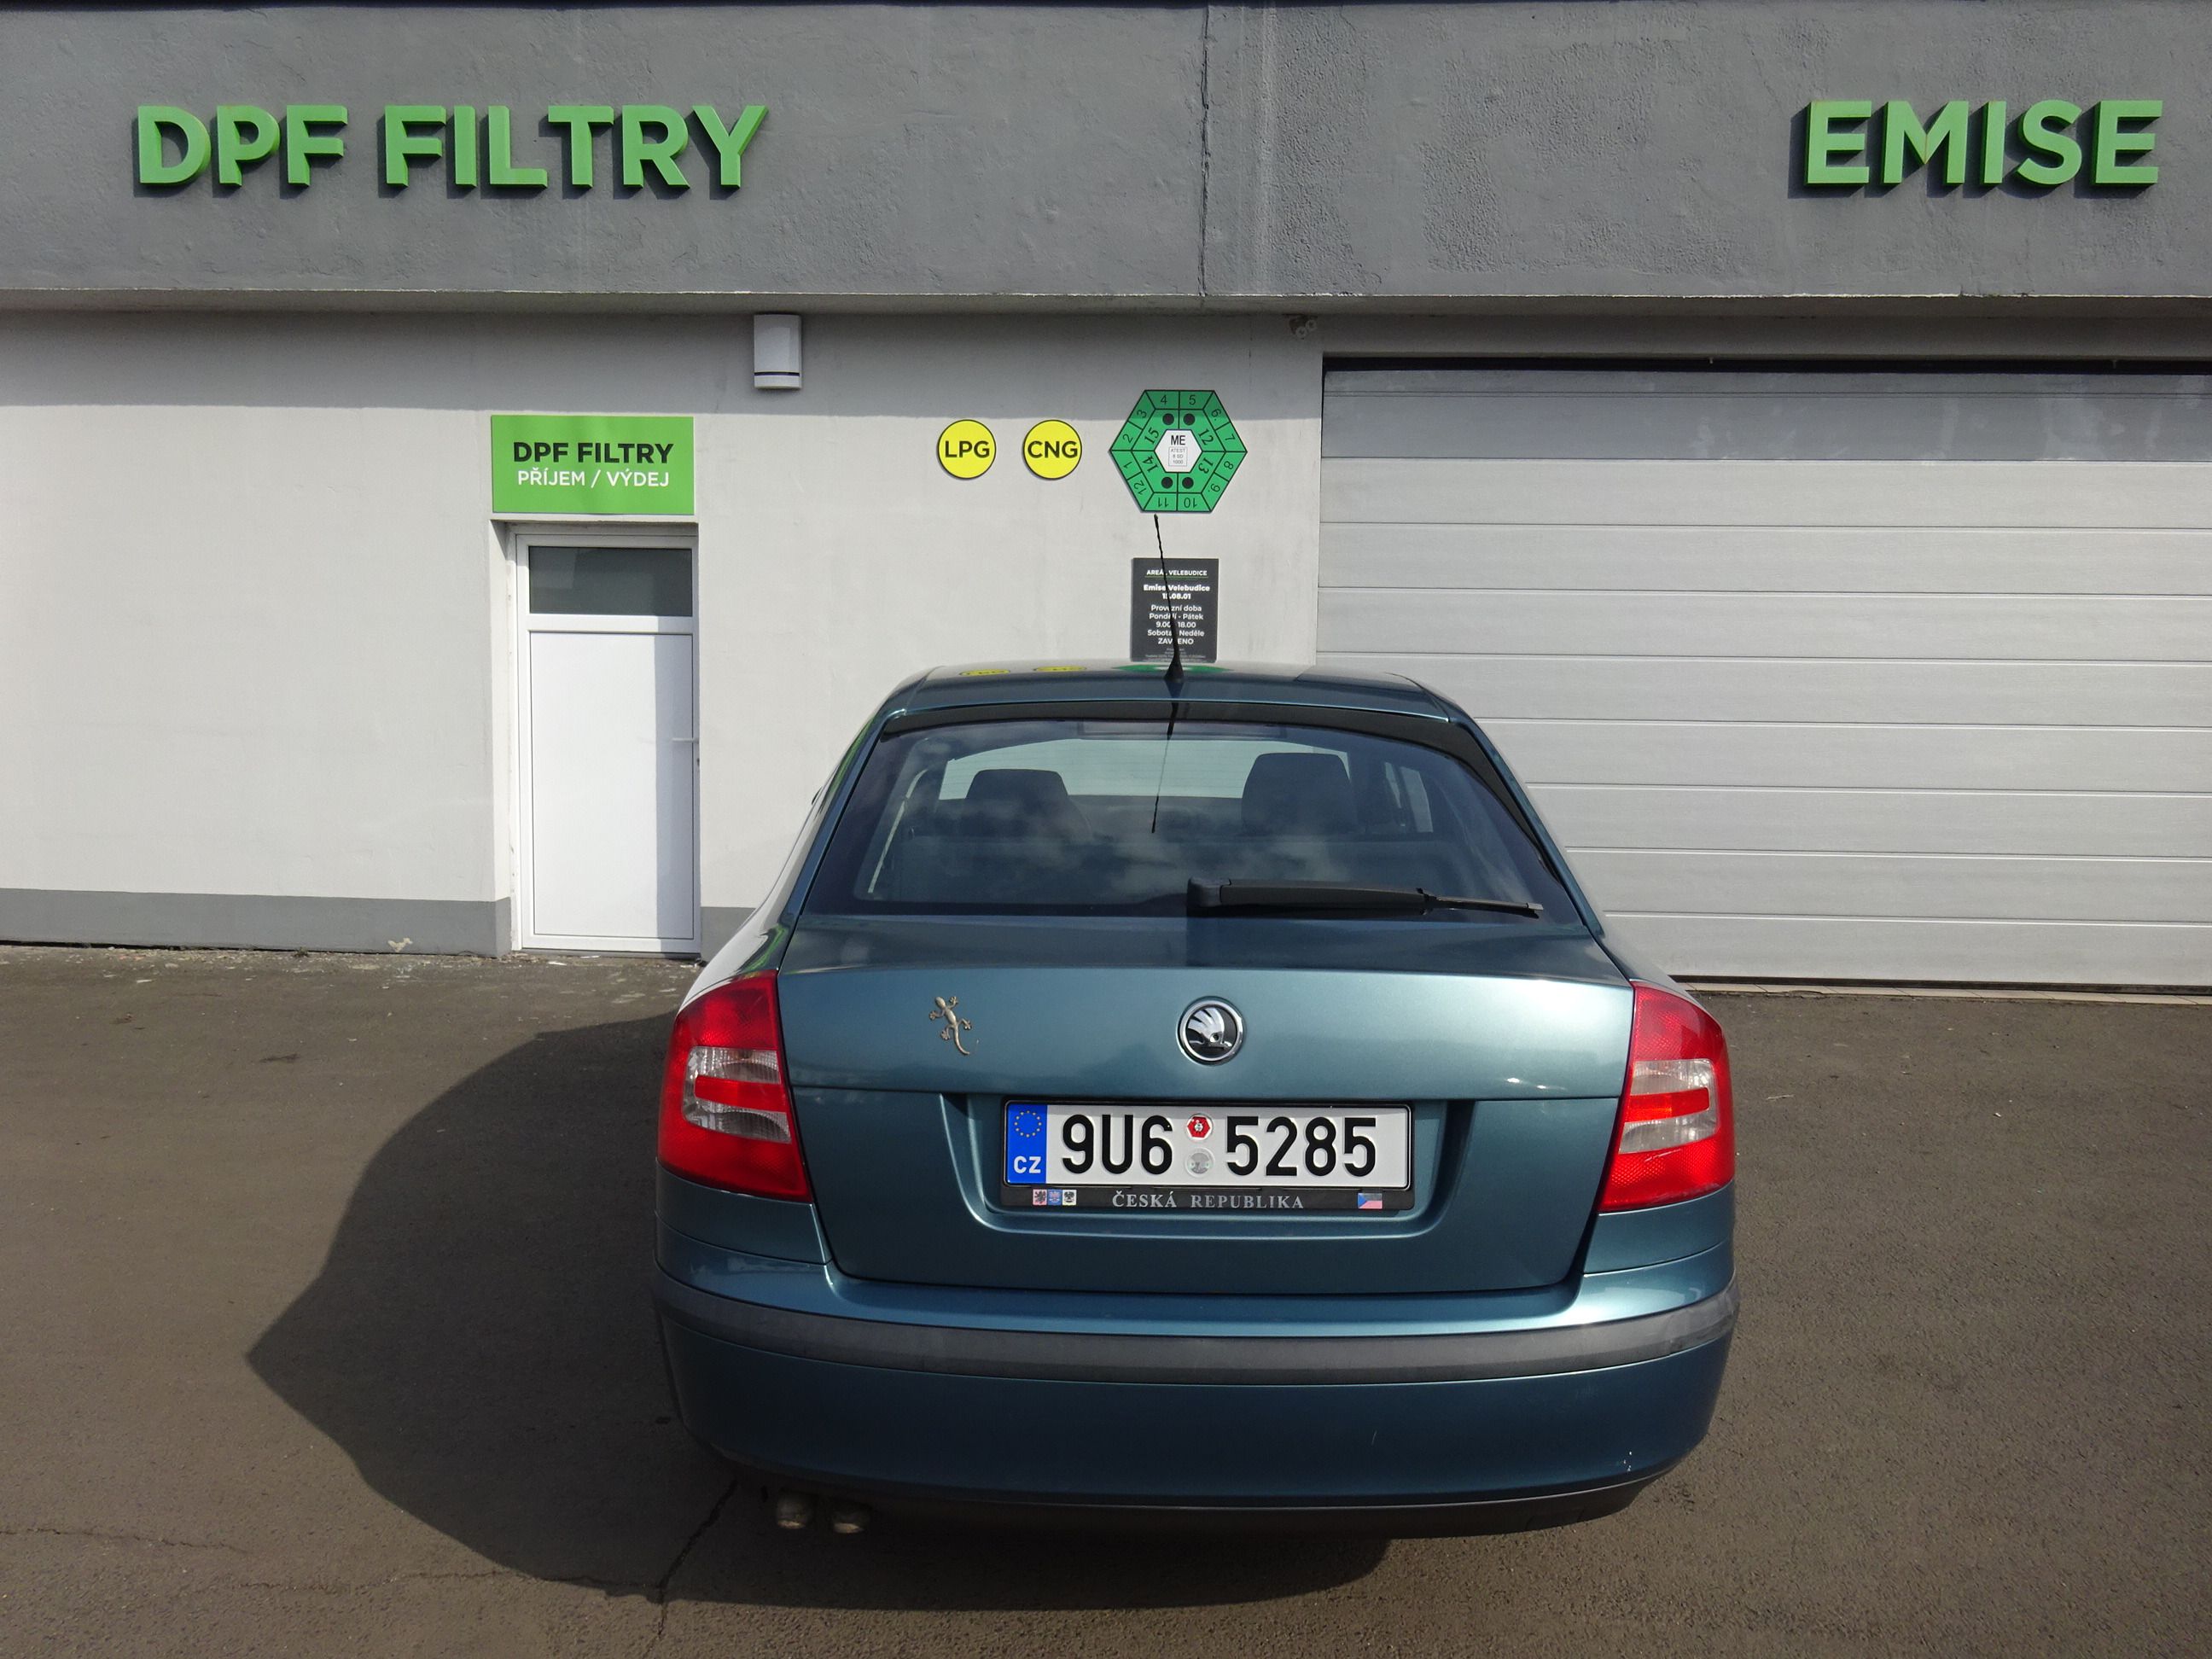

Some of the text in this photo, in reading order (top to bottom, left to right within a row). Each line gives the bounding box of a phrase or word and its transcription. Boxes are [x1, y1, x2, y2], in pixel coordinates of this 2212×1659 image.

[137, 105, 768, 189] DPF FILTRY
[1805, 100, 2163, 186] EMISE
[1160, 394, 1168, 405] 4
[1188, 394, 1196, 405] 5
[1136, 409, 1148, 418] 3
[1122, 434, 1133, 443] 2
[1144, 427, 1160, 445] 15
[1170, 434, 1185, 445] ME
[1198, 428, 1214, 445] 12
[1225, 434, 1236, 442] 7
[513, 441, 674, 464] DPF FILTRY
[944, 439, 991, 458] LPG
[1027, 439, 1079, 459] CNG
[1143, 455, 1159, 471] 14
[1197, 457, 1214, 474] 13
[1223, 461, 1234, 469] 8
[517, 467, 670, 489] PŘÍJEM / VÝDEJ
[1133, 480, 1147, 495] 12
[1157, 497, 1169, 508] 11
[1183, 497, 1197, 508] 10
[1061, 1113, 1377, 1178] 9U6 5285
[1013, 1155, 1042, 1174] CZ
[1111, 1190, 1305, 1210] ČESKÁ REPUBLIKA
